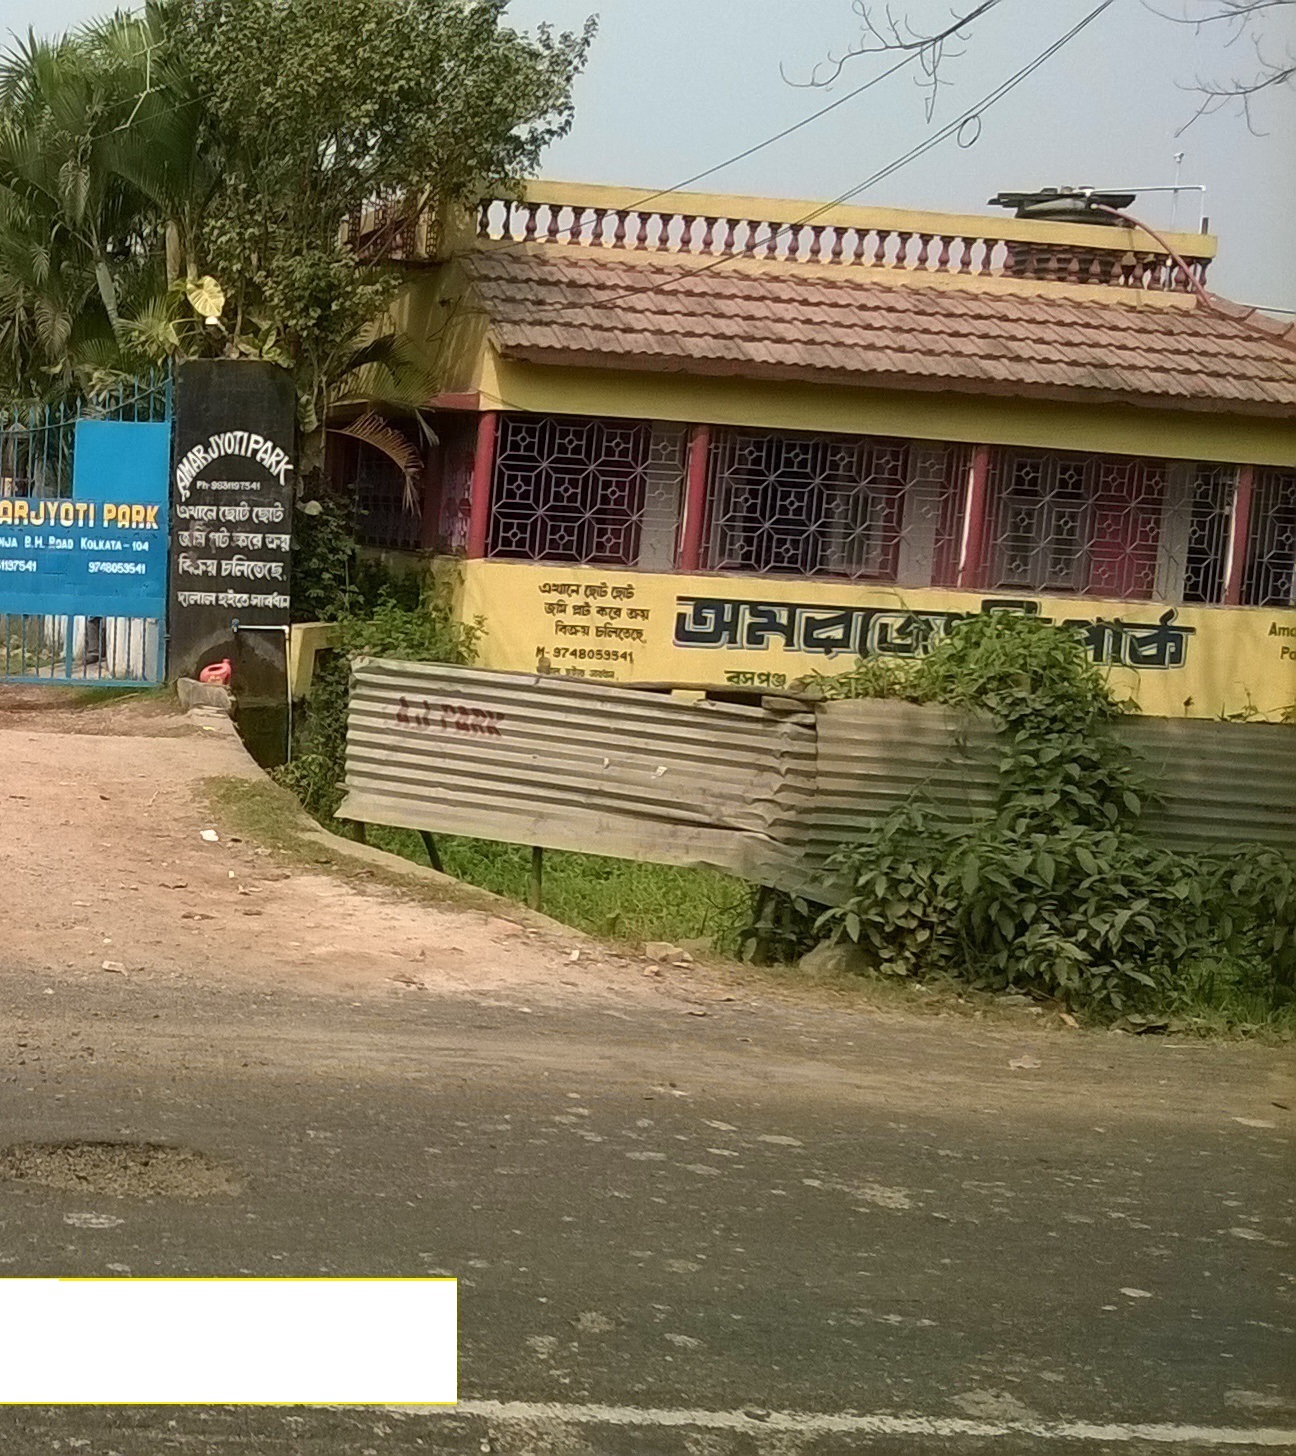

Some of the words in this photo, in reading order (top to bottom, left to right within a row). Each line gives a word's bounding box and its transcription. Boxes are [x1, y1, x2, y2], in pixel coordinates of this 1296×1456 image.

[246, 433, 294, 486] PARK
[103, 503, 159, 529] PARK
[176, 504, 217, 521] এখানে
[218, 501, 251, 522] ছোট
[252, 502, 284, 523] ছোট
[538, 582, 581, 598] এখানে
[584, 582, 609, 600] ছোট
[611, 584, 635, 601] ছোট
[544, 599, 568, 616] জমি
[552, 647, 634, 664] 9748059541
